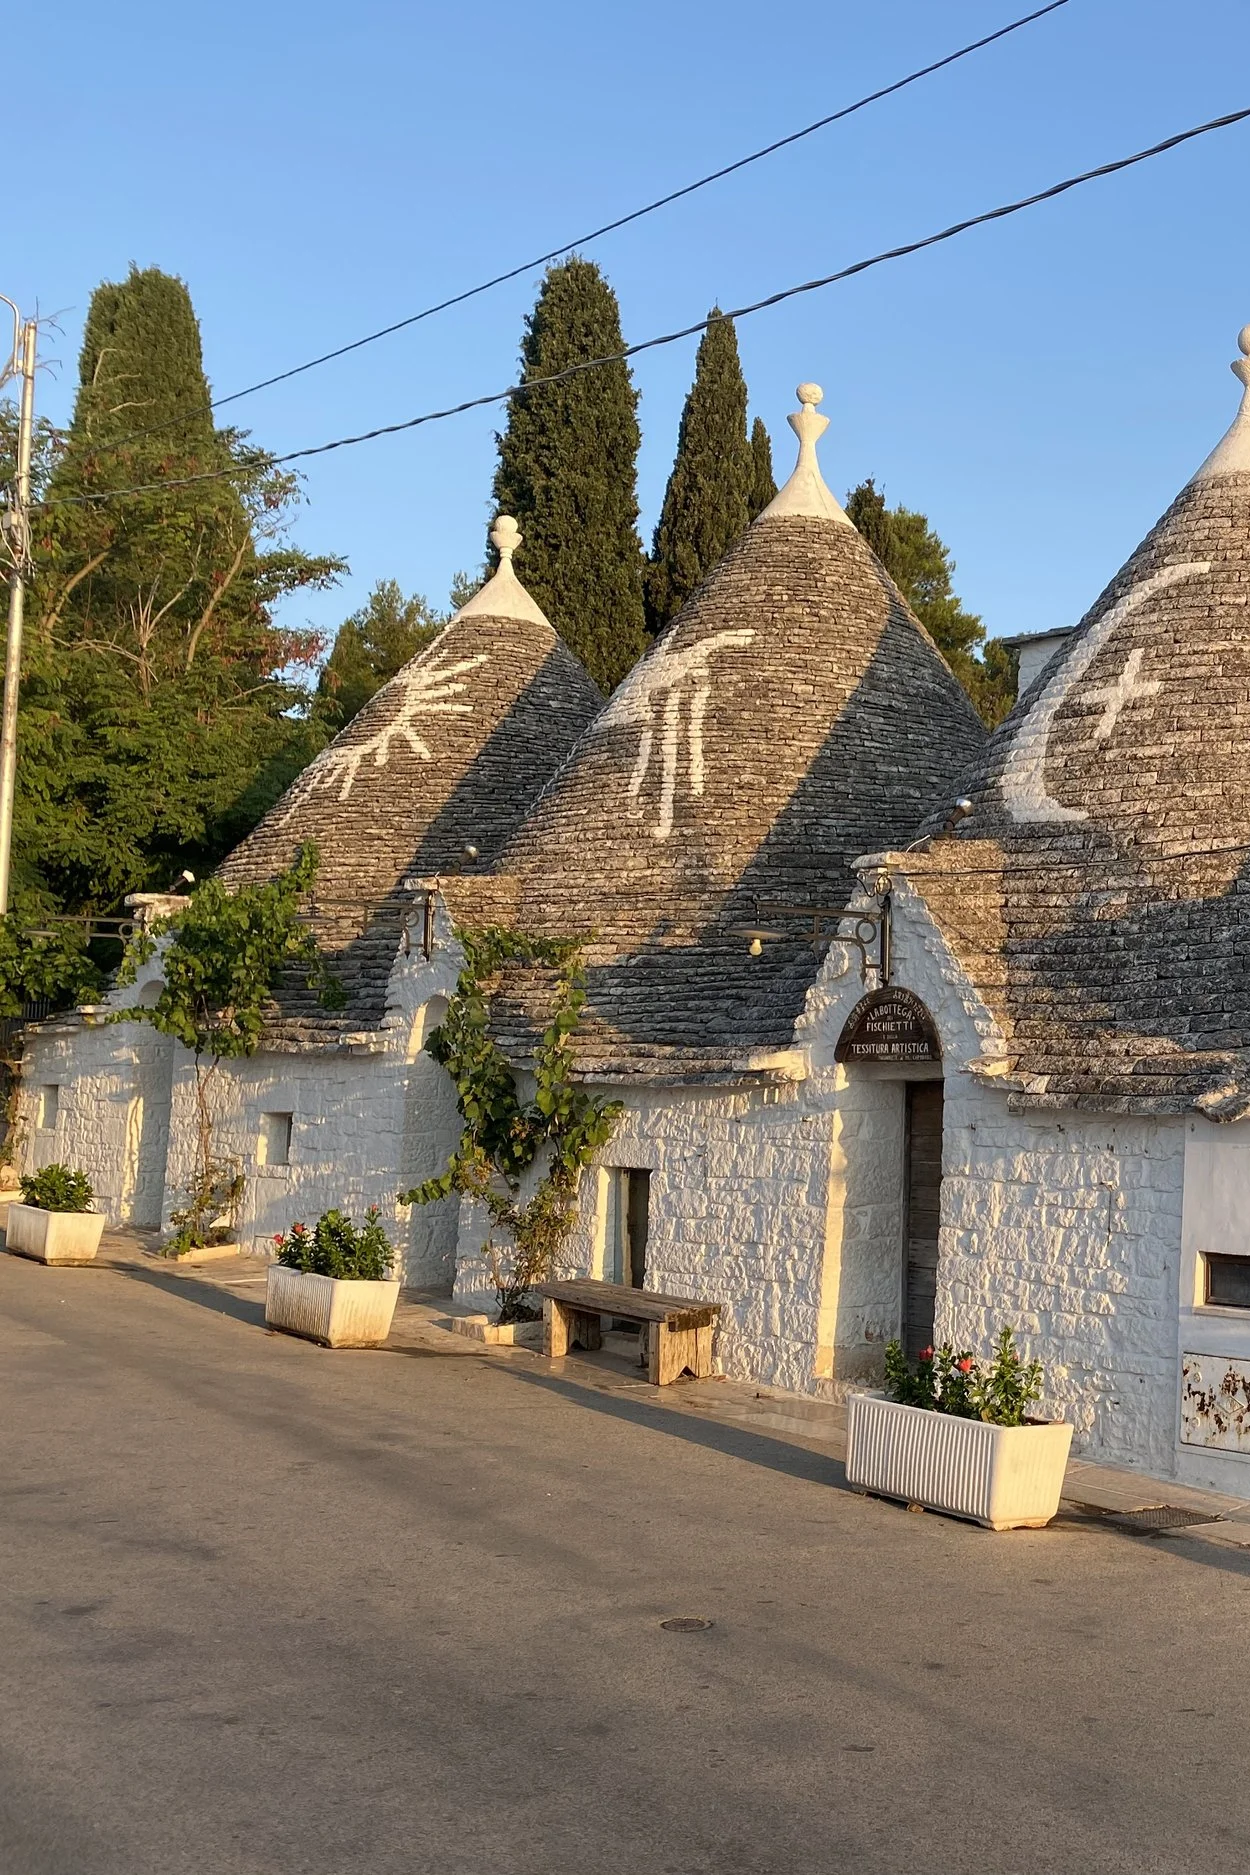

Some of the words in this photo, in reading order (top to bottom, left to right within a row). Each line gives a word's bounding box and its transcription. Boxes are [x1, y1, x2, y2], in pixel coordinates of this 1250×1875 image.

[880, 1003, 913, 1020] BOTTEGA
[866, 1021, 913, 1031] FISCHIETTI
[851, 1043, 889, 1054] TESSITURA
[891, 1042, 929, 1054] ARTISTICA
